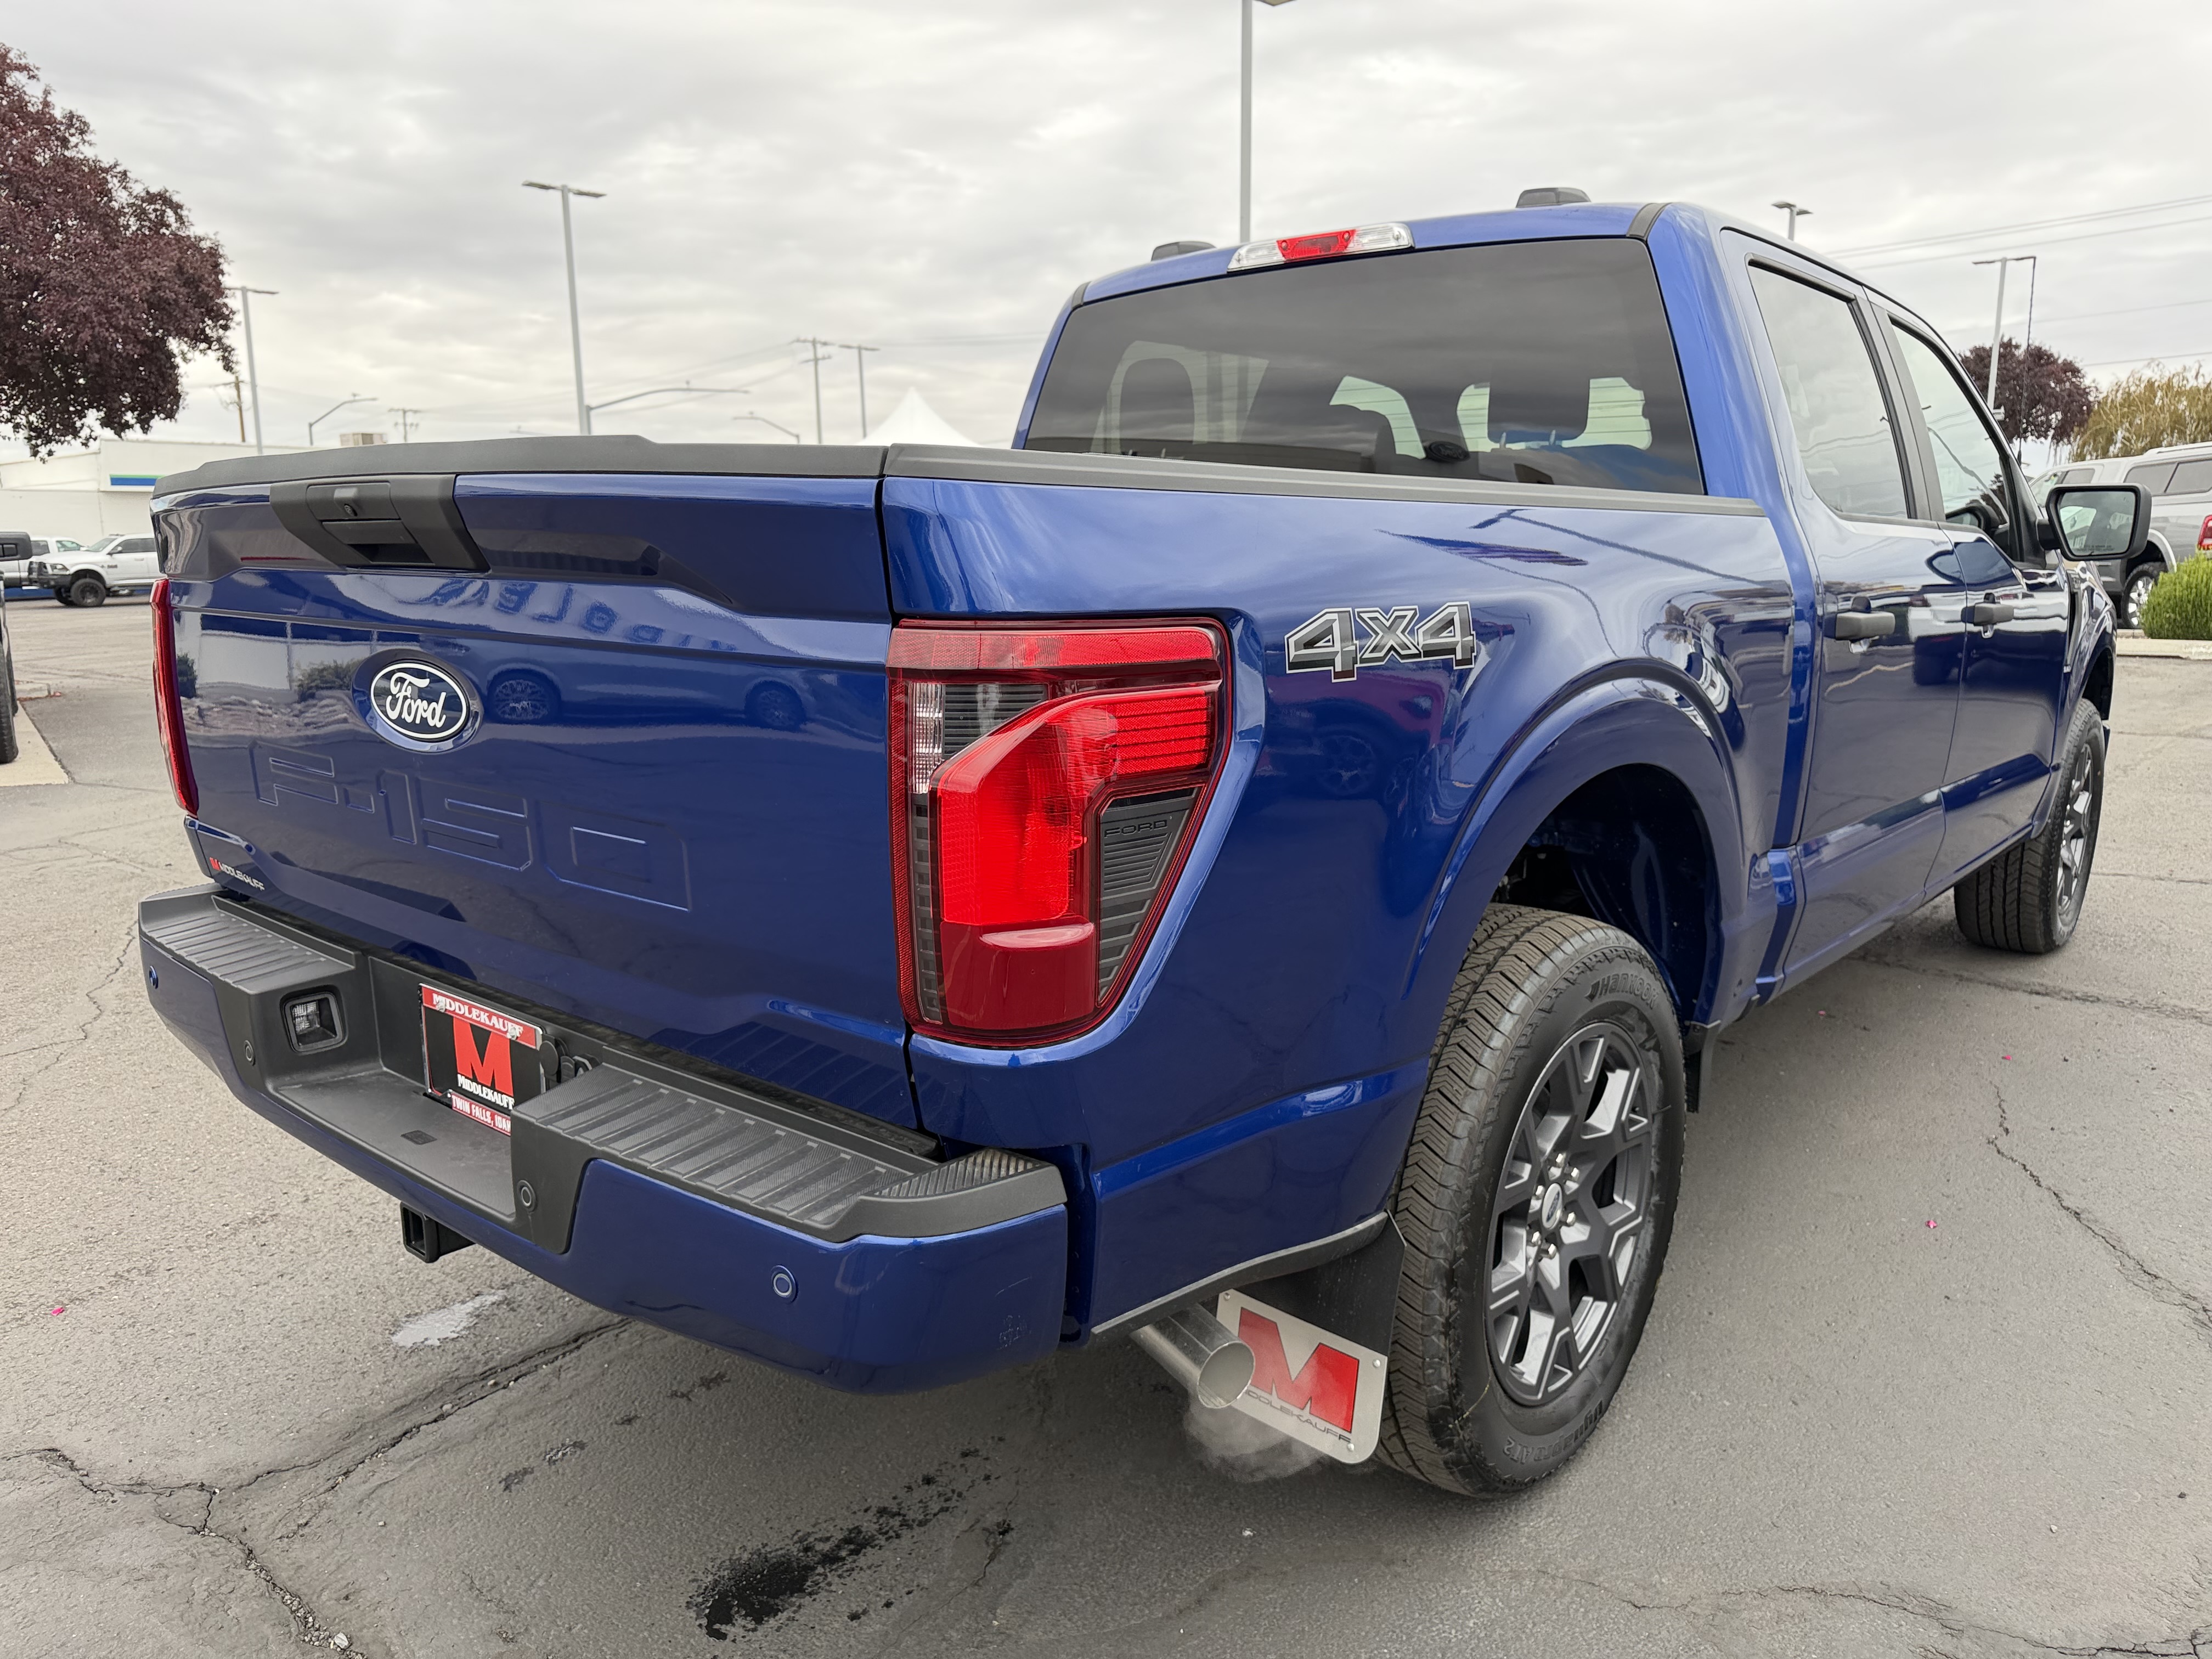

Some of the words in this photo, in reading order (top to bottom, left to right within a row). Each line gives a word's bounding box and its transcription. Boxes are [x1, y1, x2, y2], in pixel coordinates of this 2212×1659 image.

[386, 672, 447, 727] Ford
[249, 741, 691, 912] F-150
[1104, 820, 1167, 838] FORD
[453, 1015, 514, 1097] M
[452, 1095, 470, 1113] TWIN
[495, 1114, 511, 1132] IDAH
[457, 1074, 515, 1110] MIDDLEKAUFF
[1238, 1307, 1359, 1434] M
[1245, 1389, 1351, 1443] IDDLEKAUFF
